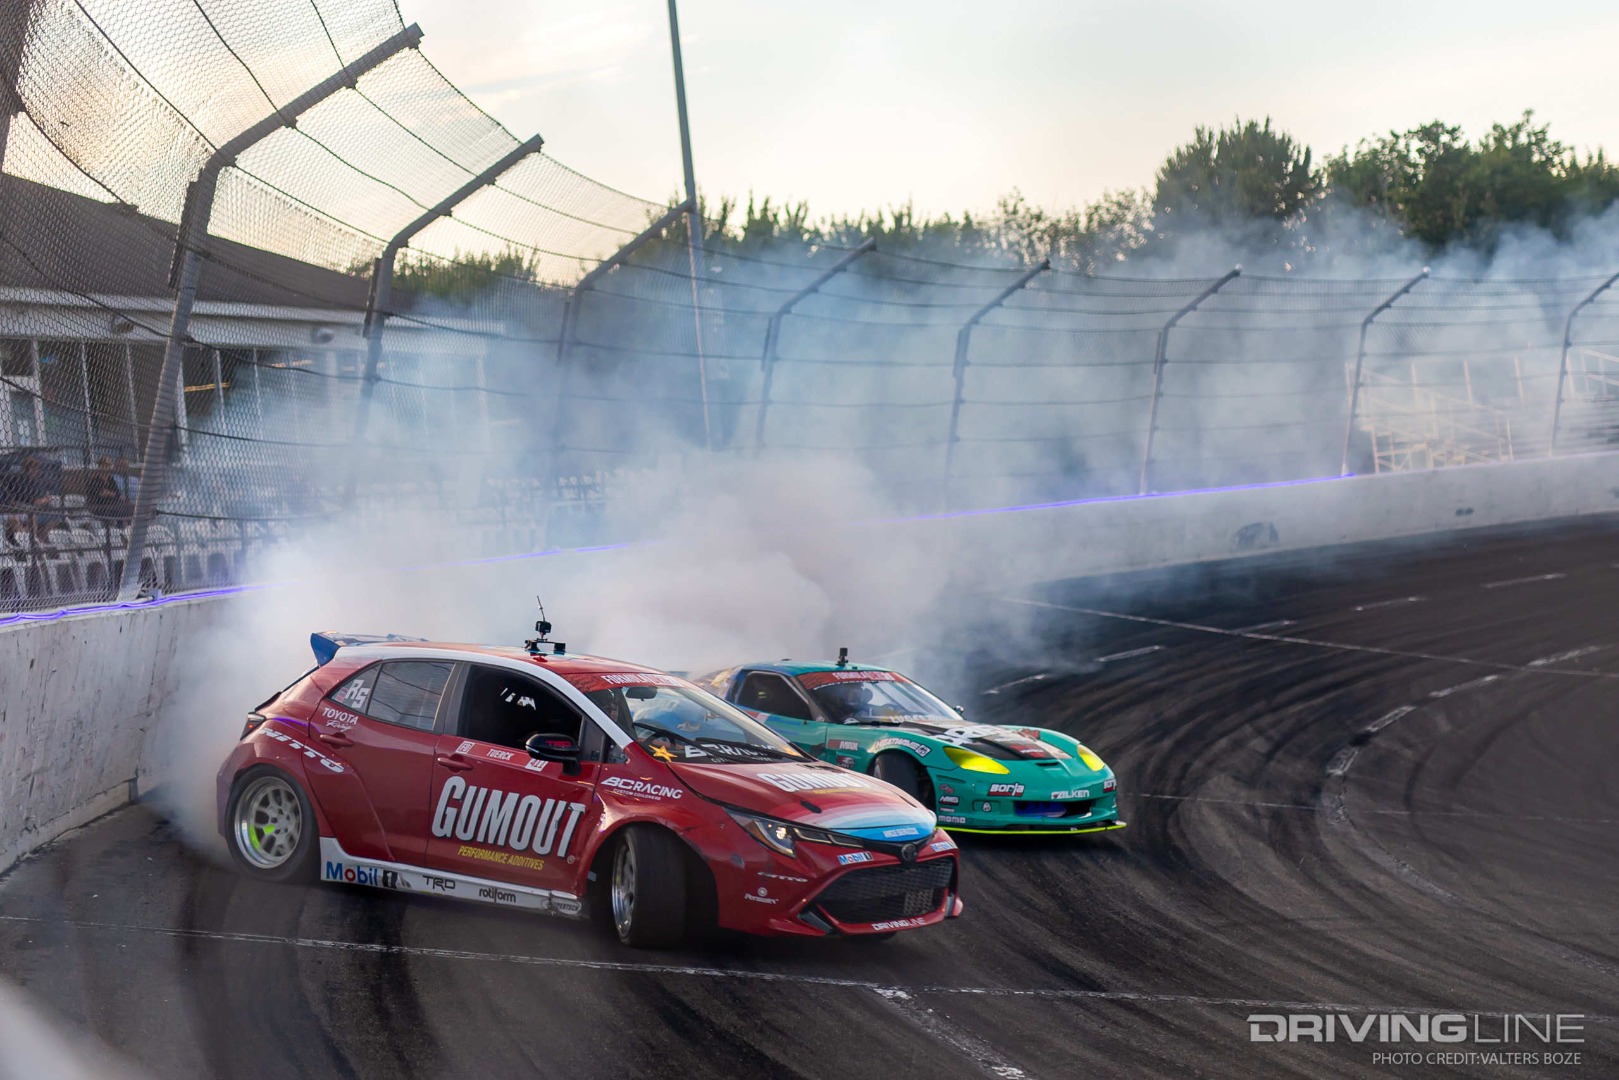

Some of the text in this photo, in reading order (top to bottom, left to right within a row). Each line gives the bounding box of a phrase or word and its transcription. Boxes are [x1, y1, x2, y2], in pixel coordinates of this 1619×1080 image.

[322, 707, 359, 725] TOYOTA
[259, 727, 344, 773] NITTO
[486, 748, 515, 761] TUERCK
[431, 775, 586, 858] GUMOUT
[457, 845, 545, 871] PERFORMANCE ADDITIVES
[838, 852, 864, 865] Mobil
[325, 861, 398, 888] Mobil 1
[422, 874, 456, 891] TRD
[478, 887, 517, 903] rotiform
